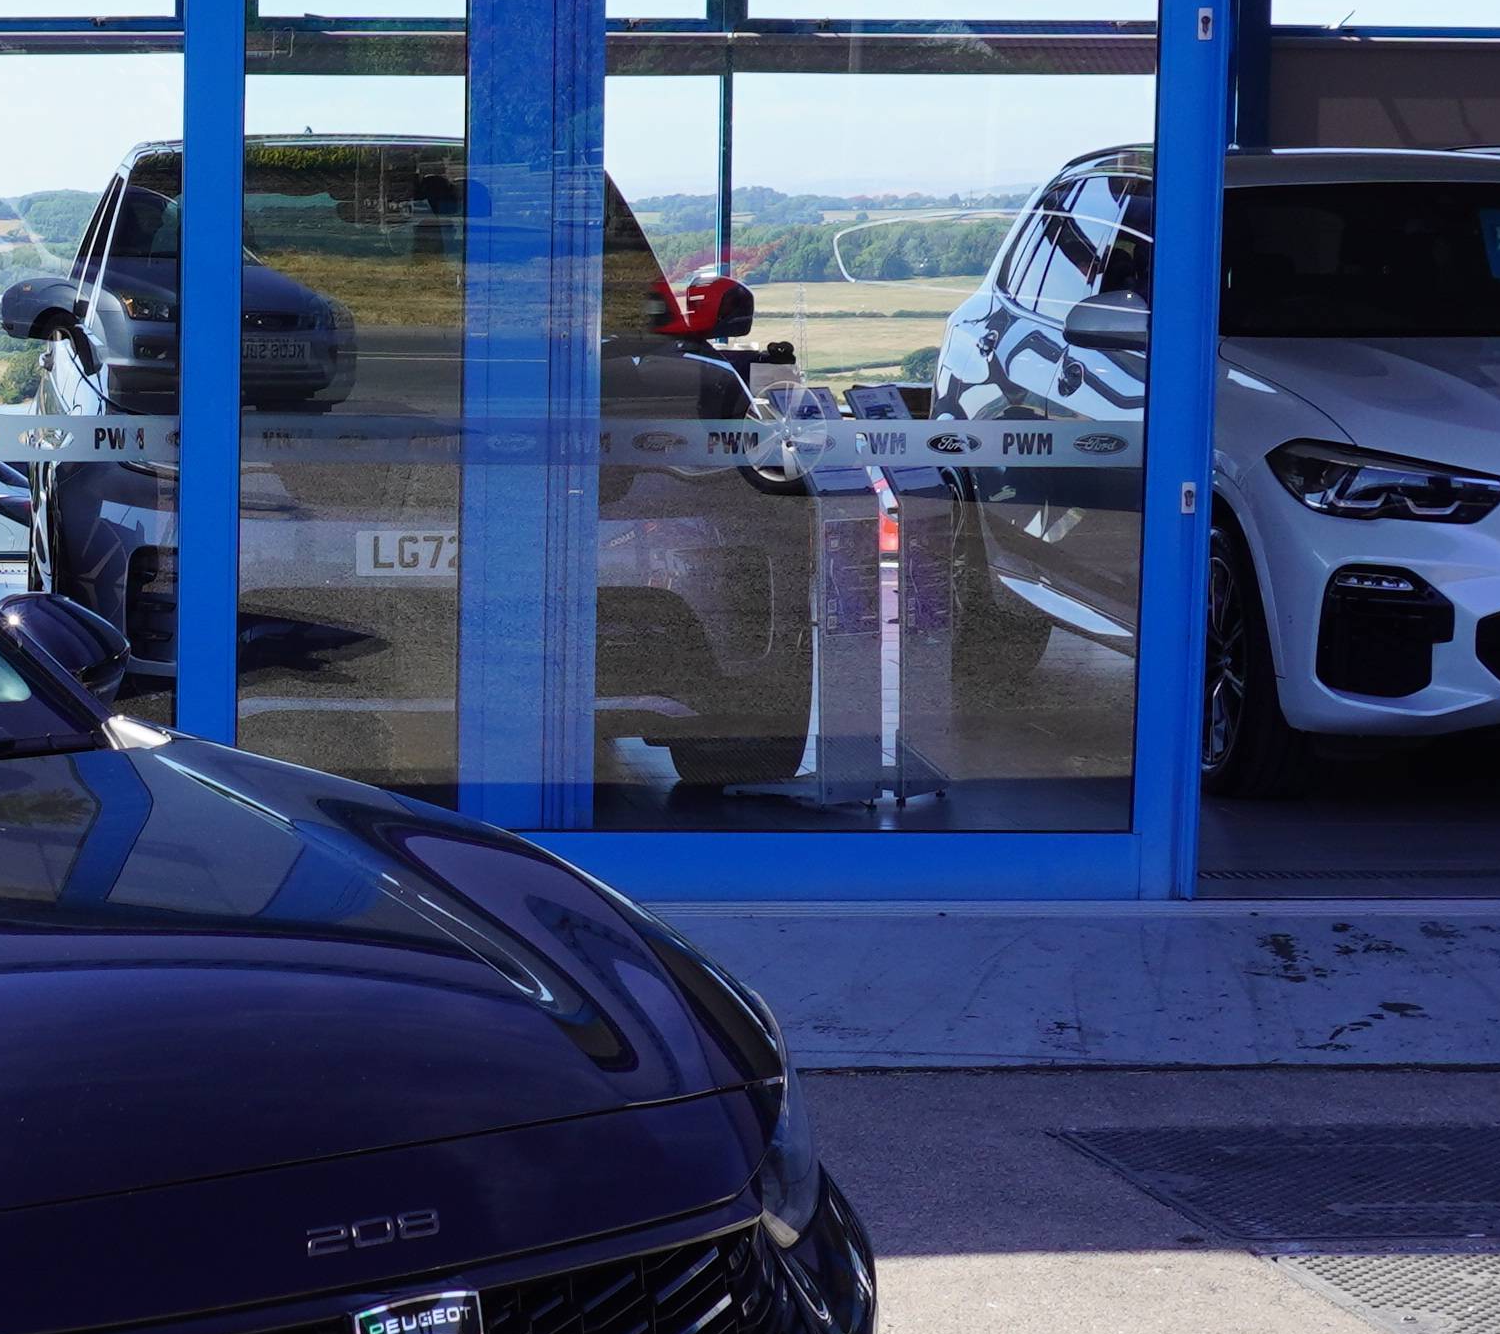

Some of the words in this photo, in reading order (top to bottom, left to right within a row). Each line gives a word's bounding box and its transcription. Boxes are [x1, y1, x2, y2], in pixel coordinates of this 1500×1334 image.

[707, 431, 759, 455] PWM
[854, 432, 907, 454] PWM
[1002, 432, 1053, 455] PWM
[306, 1208, 441, 1257] 208
